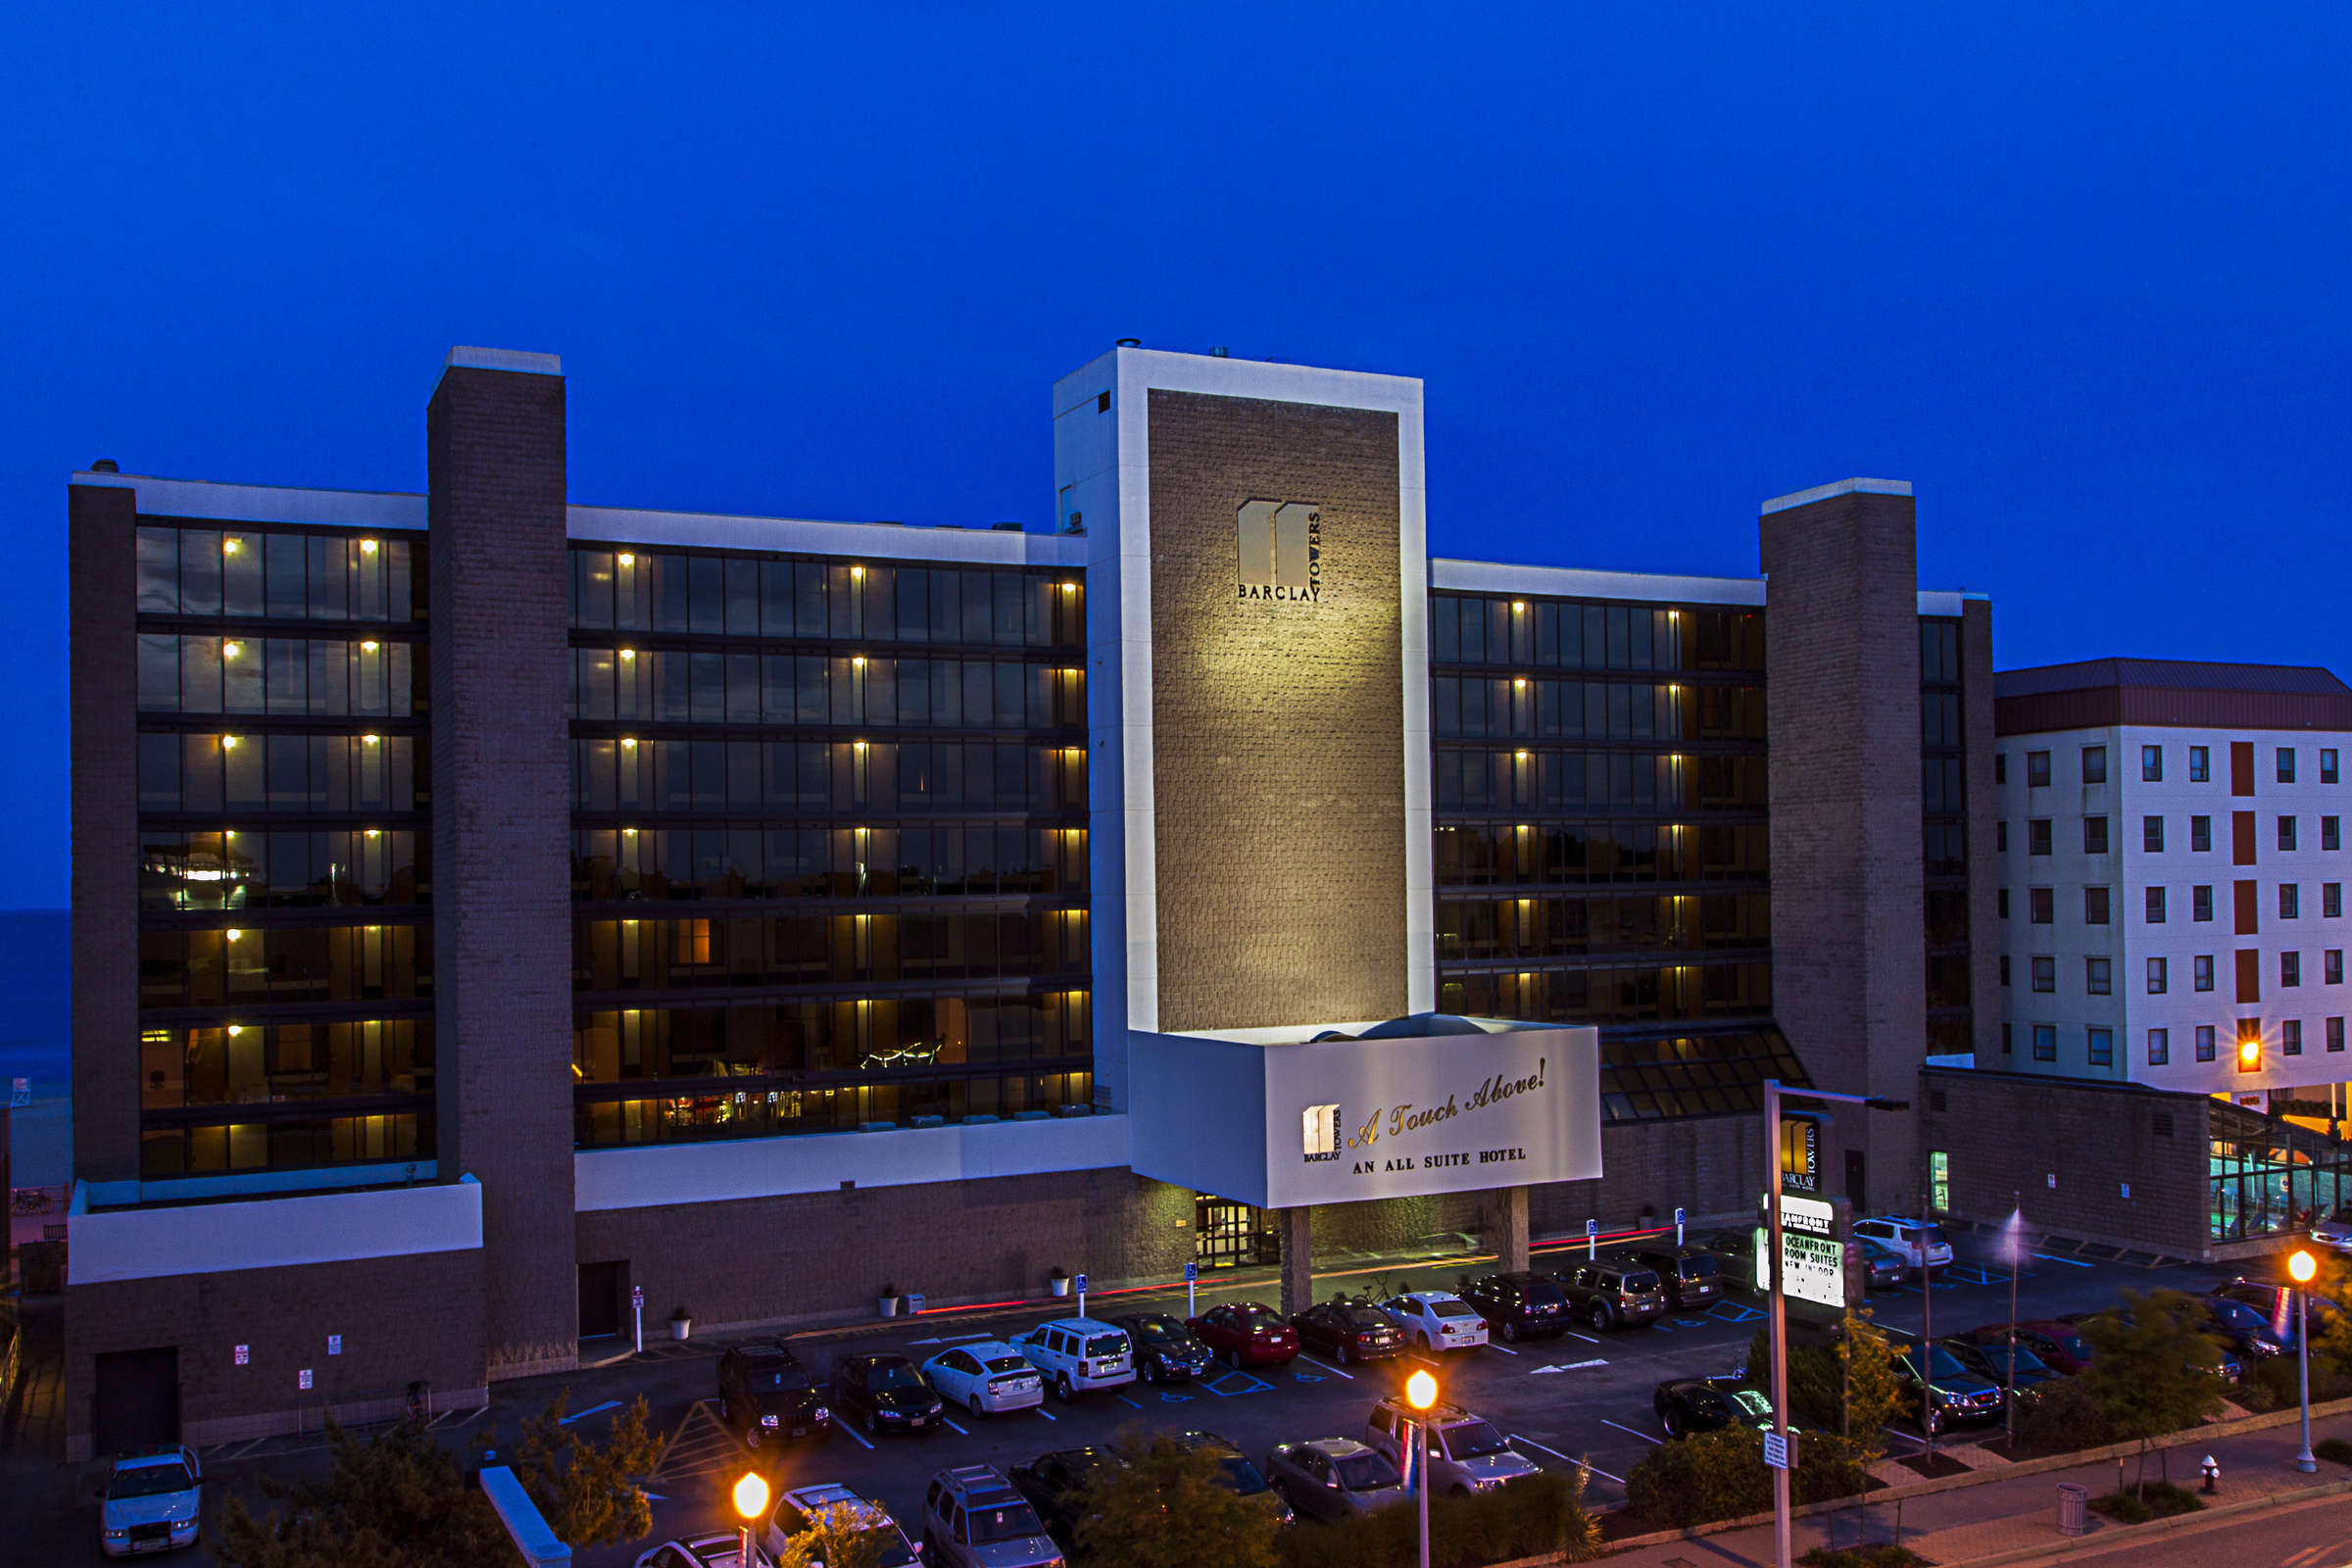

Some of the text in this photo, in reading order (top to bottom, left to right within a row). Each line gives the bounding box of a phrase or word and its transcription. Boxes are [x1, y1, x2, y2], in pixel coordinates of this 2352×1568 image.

[1308, 512, 1320, 589] TOWERS
[1238, 583, 1321, 603] BARCLAY
[1348, 1057, 1546, 1150] A Touch Above!
[1333, 1108, 1342, 1152] TOWERS
[1303, 1151, 1342, 1163] BARCLAY
[1352, 1148, 1527, 1175] AN ALL SUITE HOTEL
[1806, 1128, 1816, 1175] TOWERS
[1785, 1248, 1838, 1268] ROOM SUITES
[1786, 1236, 1837, 1255] OCEANFRONT
